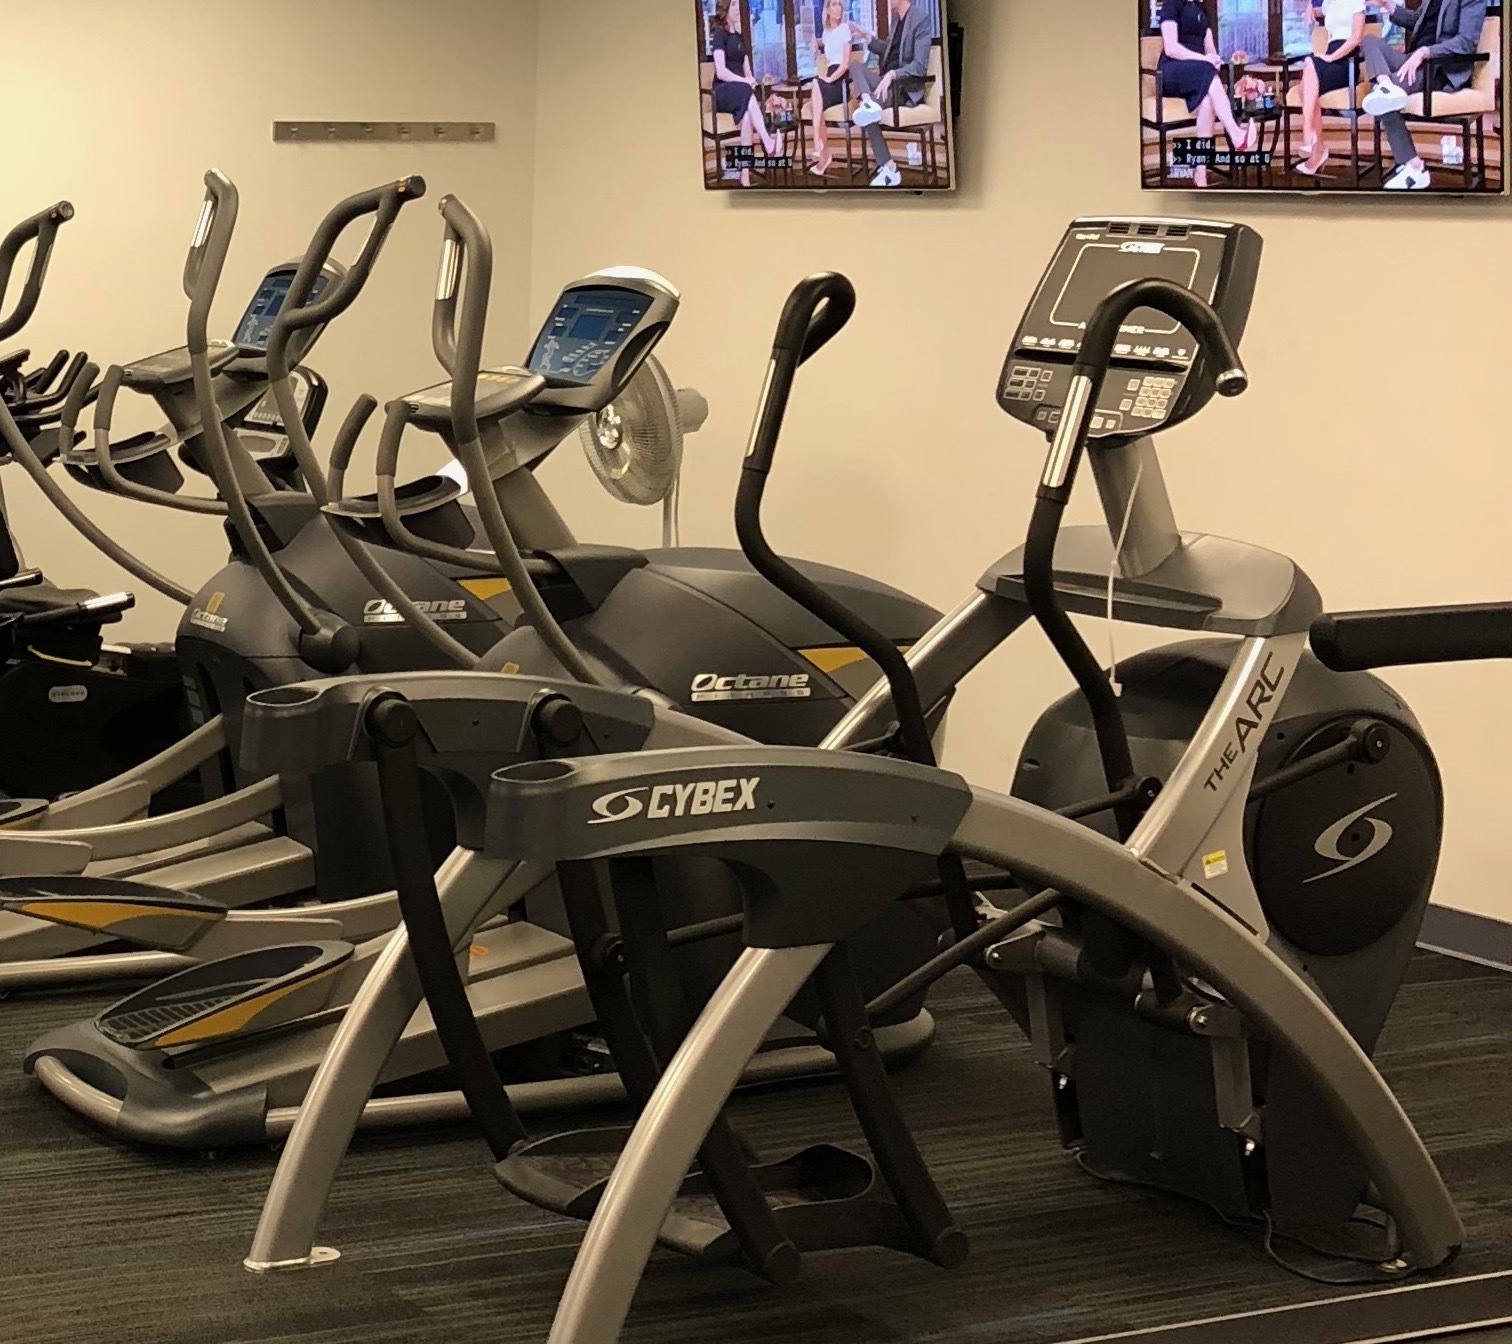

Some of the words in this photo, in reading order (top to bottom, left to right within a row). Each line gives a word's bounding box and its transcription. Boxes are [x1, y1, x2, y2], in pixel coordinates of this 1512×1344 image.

[1215, 153, 1231, 163] And
[1234, 155, 1246, 164] so
[363, 599, 466, 614] Ocane
[690, 673, 810, 692] Octane
[1203, 741, 1239, 792] THE
[1235, 651, 1285, 754] ARC
[646, 776, 761, 819] CYBEX
